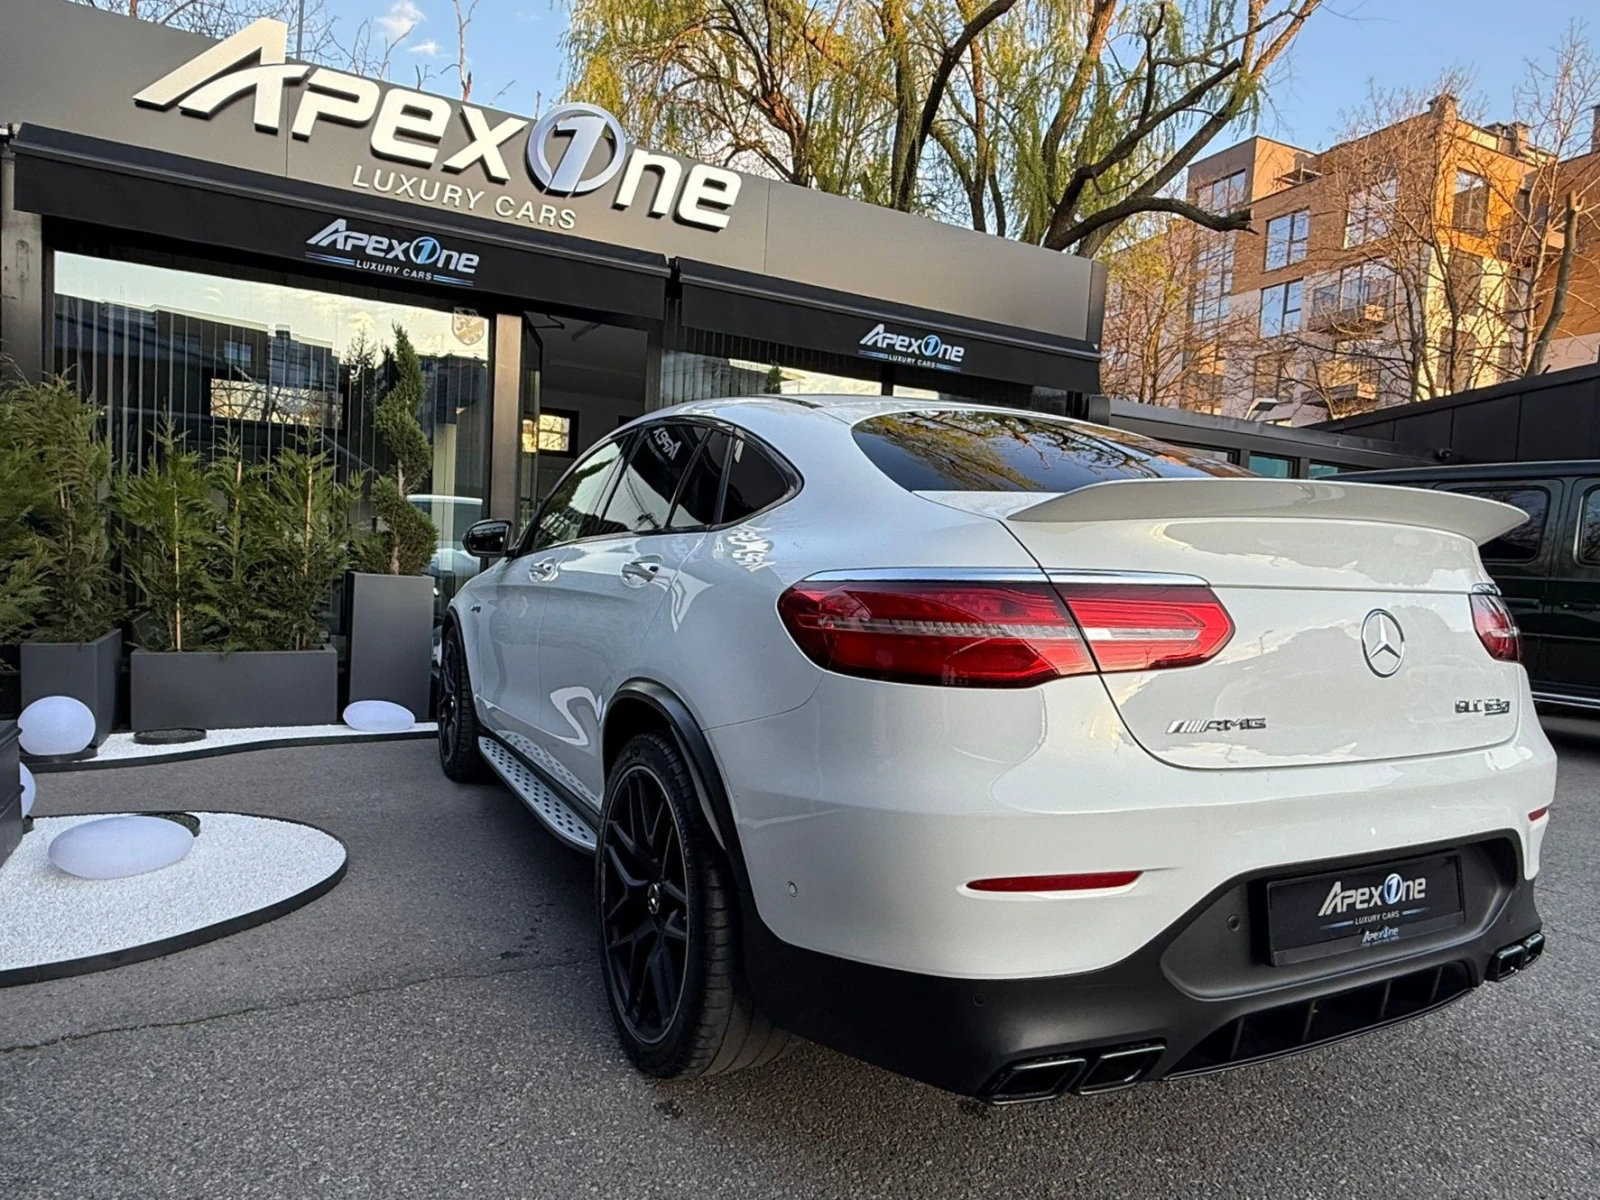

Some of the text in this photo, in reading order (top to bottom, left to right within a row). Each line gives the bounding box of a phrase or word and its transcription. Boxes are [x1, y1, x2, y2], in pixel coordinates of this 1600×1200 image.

[352, 165, 577, 230] LUXURY CARS
[355, 259, 433, 281] LUXURY CARS
[888, 353, 936, 369] LUXURY CARS
[1201, 718, 1267, 733] AMG
[1354, 910, 1400, 925] LUXURY CARS
